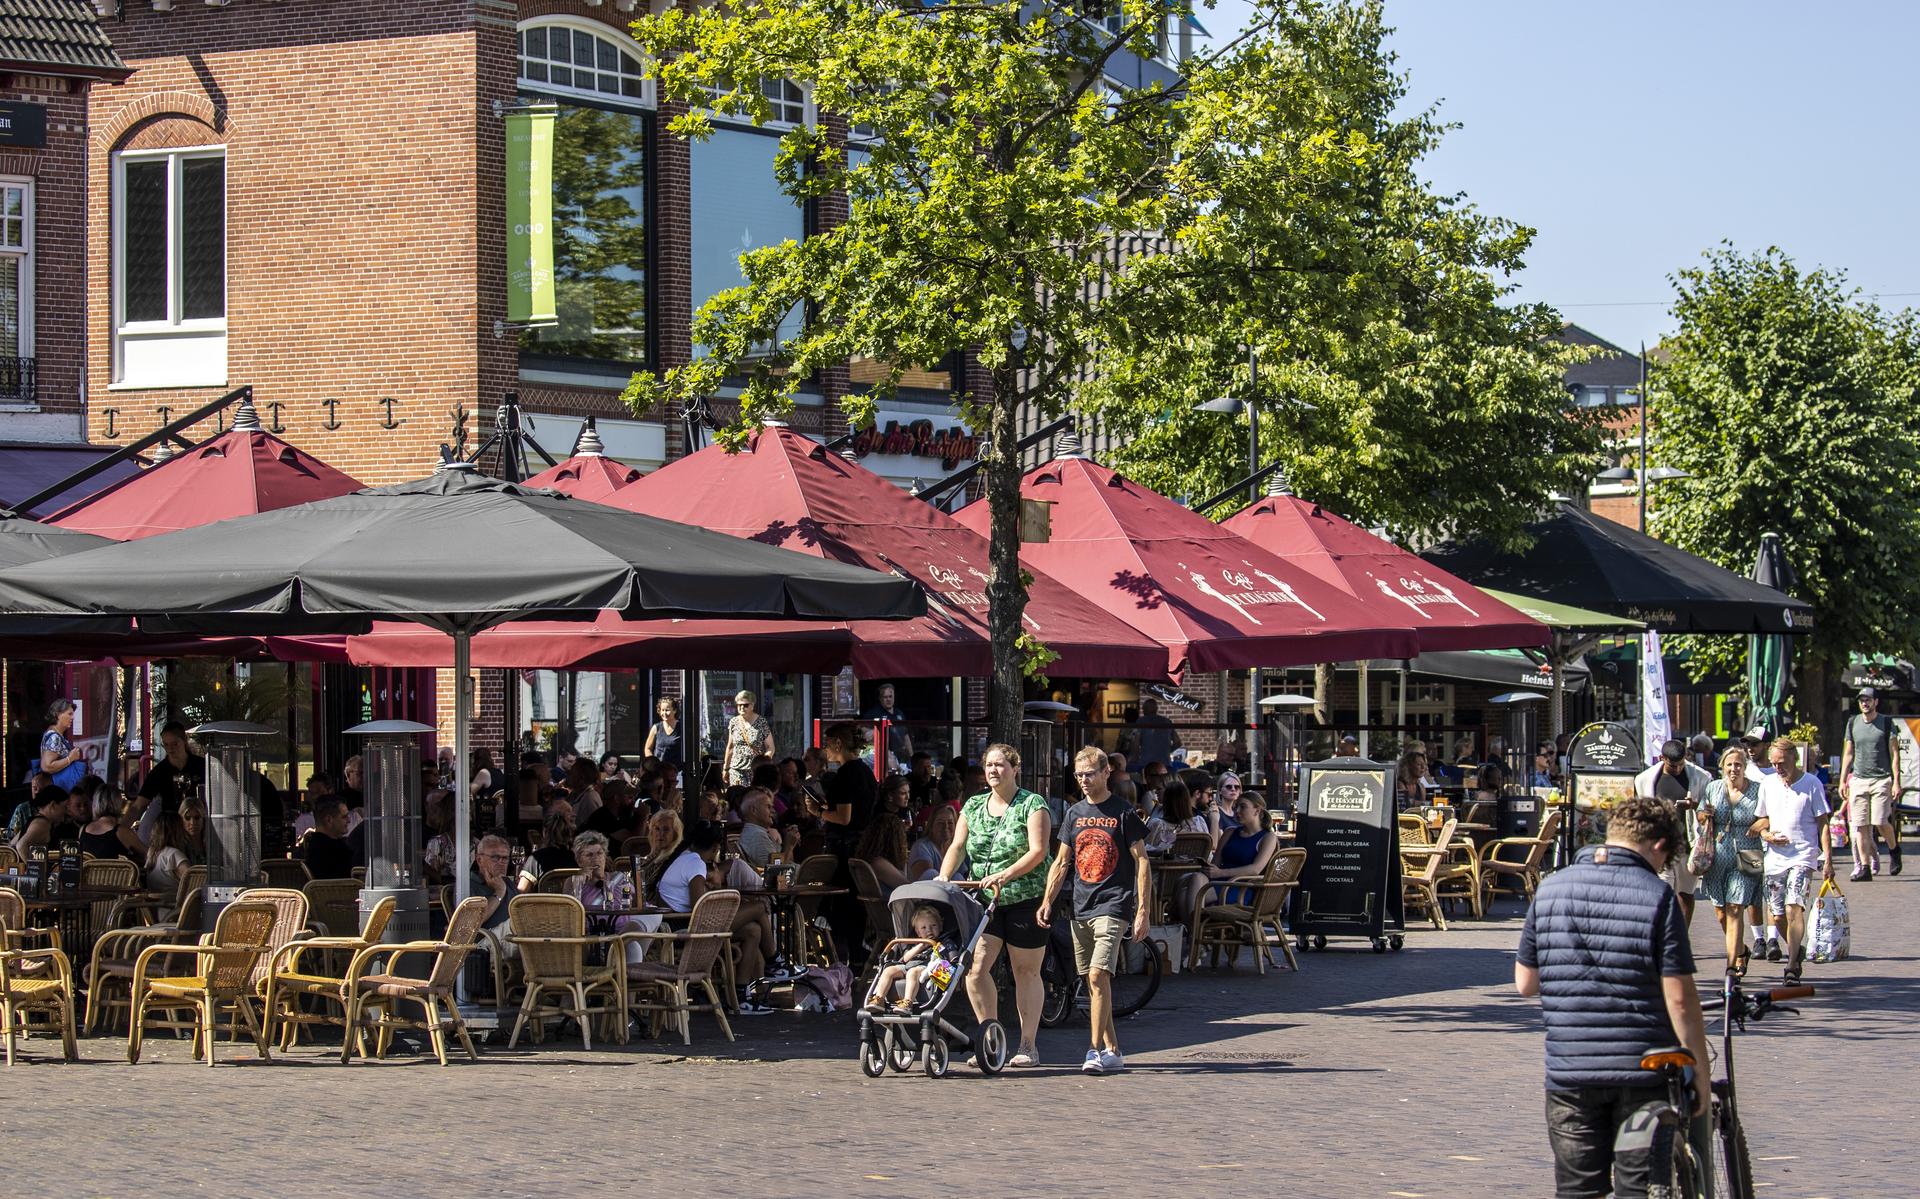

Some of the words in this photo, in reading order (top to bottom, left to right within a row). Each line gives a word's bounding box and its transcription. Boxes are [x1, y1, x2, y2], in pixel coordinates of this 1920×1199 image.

[928, 561, 964, 590] Café
[1586, 744, 1610, 752] BARISTA
[1075, 816, 1118, 828] STORM
